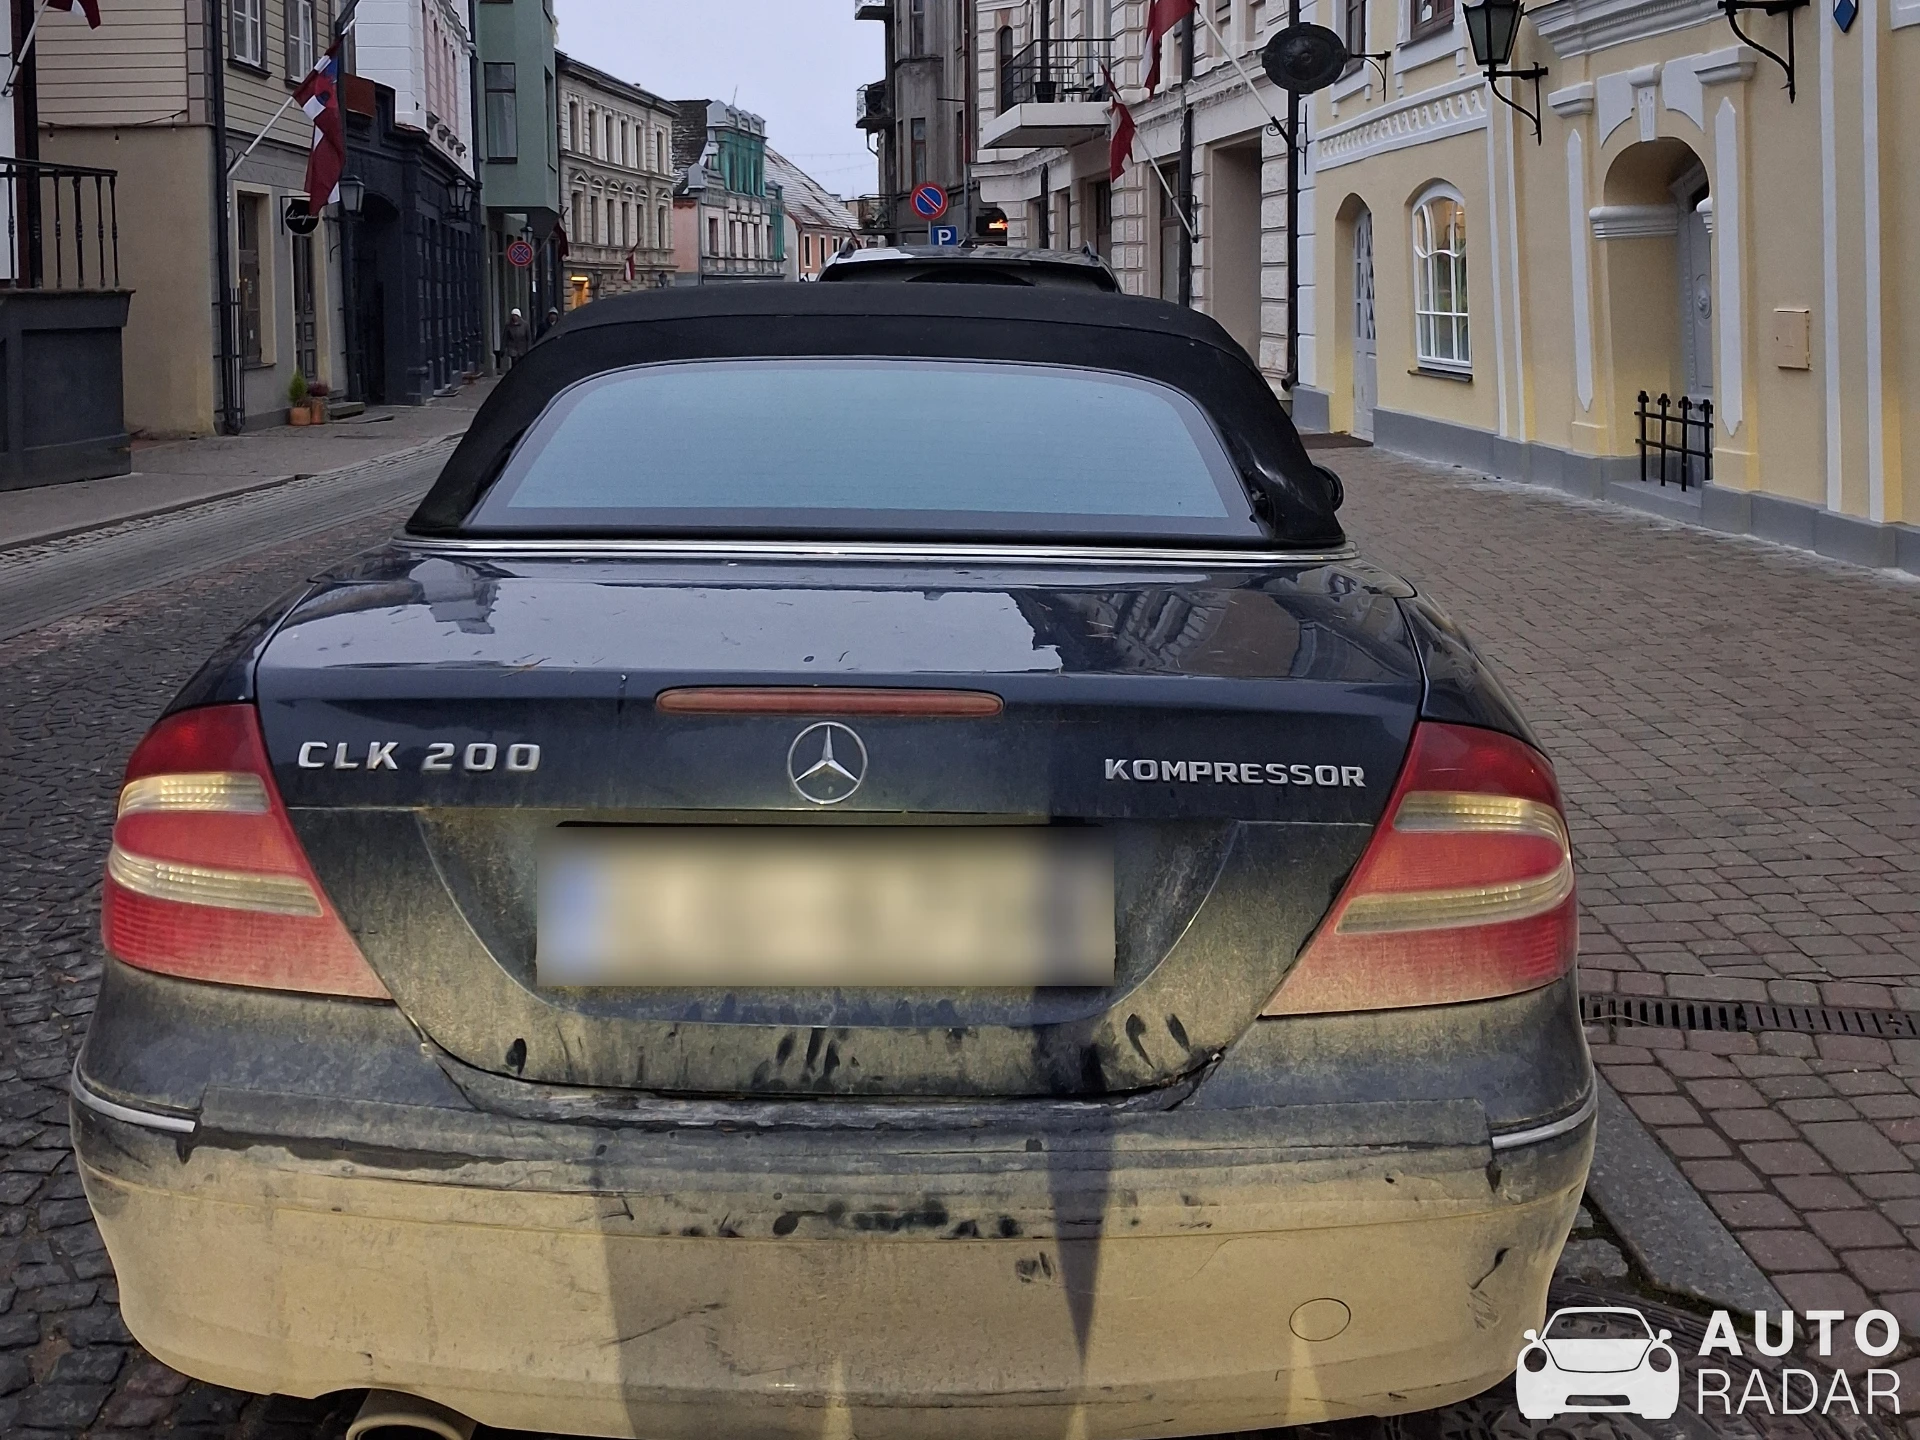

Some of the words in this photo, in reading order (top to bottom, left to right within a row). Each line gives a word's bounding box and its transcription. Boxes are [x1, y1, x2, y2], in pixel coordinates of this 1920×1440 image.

[938, 229, 952, 246] P
[298, 741, 399, 771] CLK
[421, 742, 541, 772] 200
[1104, 758, 1367, 788] KOMPRESSOR
